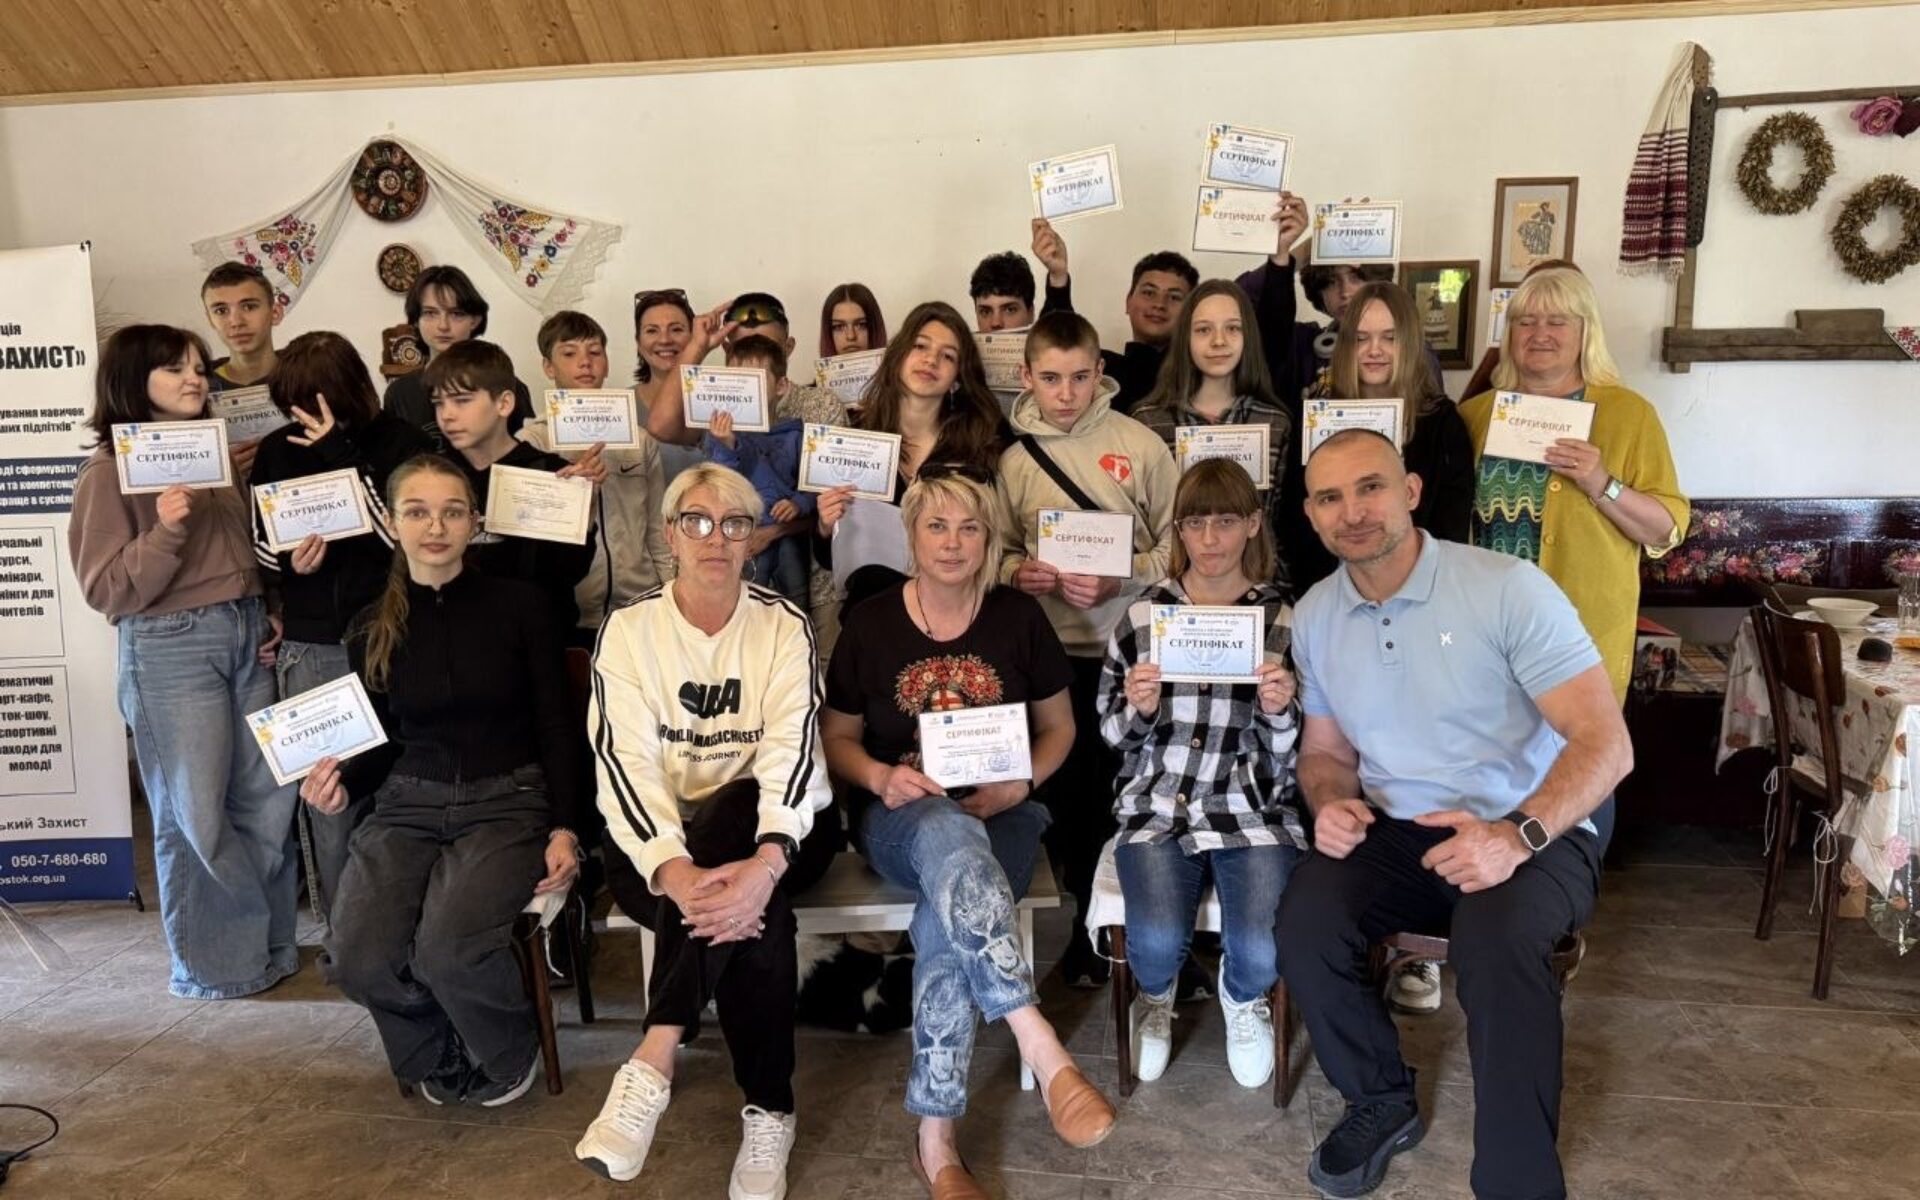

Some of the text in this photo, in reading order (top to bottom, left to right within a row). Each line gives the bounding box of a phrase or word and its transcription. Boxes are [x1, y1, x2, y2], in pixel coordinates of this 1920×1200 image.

[1219, 150, 1277, 167] СЕРТИФІКАТ
[563, 415, 623, 424] СЕРТИФІКАТ
[1508, 418, 1572, 433] СЕРТИФІКАТ
[136, 450, 210, 463] СЕРТИФІКАТ
[818, 455, 881, 470] СЕРТИФІКАТ
[280, 499, 348, 519] СЕРТИФІКАТ
[1055, 533, 1114, 545] СЕРТИФІКАТ
[31, 589, 54, 600] для
[1169, 638, 1244, 649] СЕРТИФІКАТ
[281, 711, 355, 747] СЕРТИФІКАТ
[40, 743, 62, 755] для
[9, 759, 51, 771] молоді
[38, 817, 87, 829] Захист
[11, 852, 108, 868] 050-7-680-680
